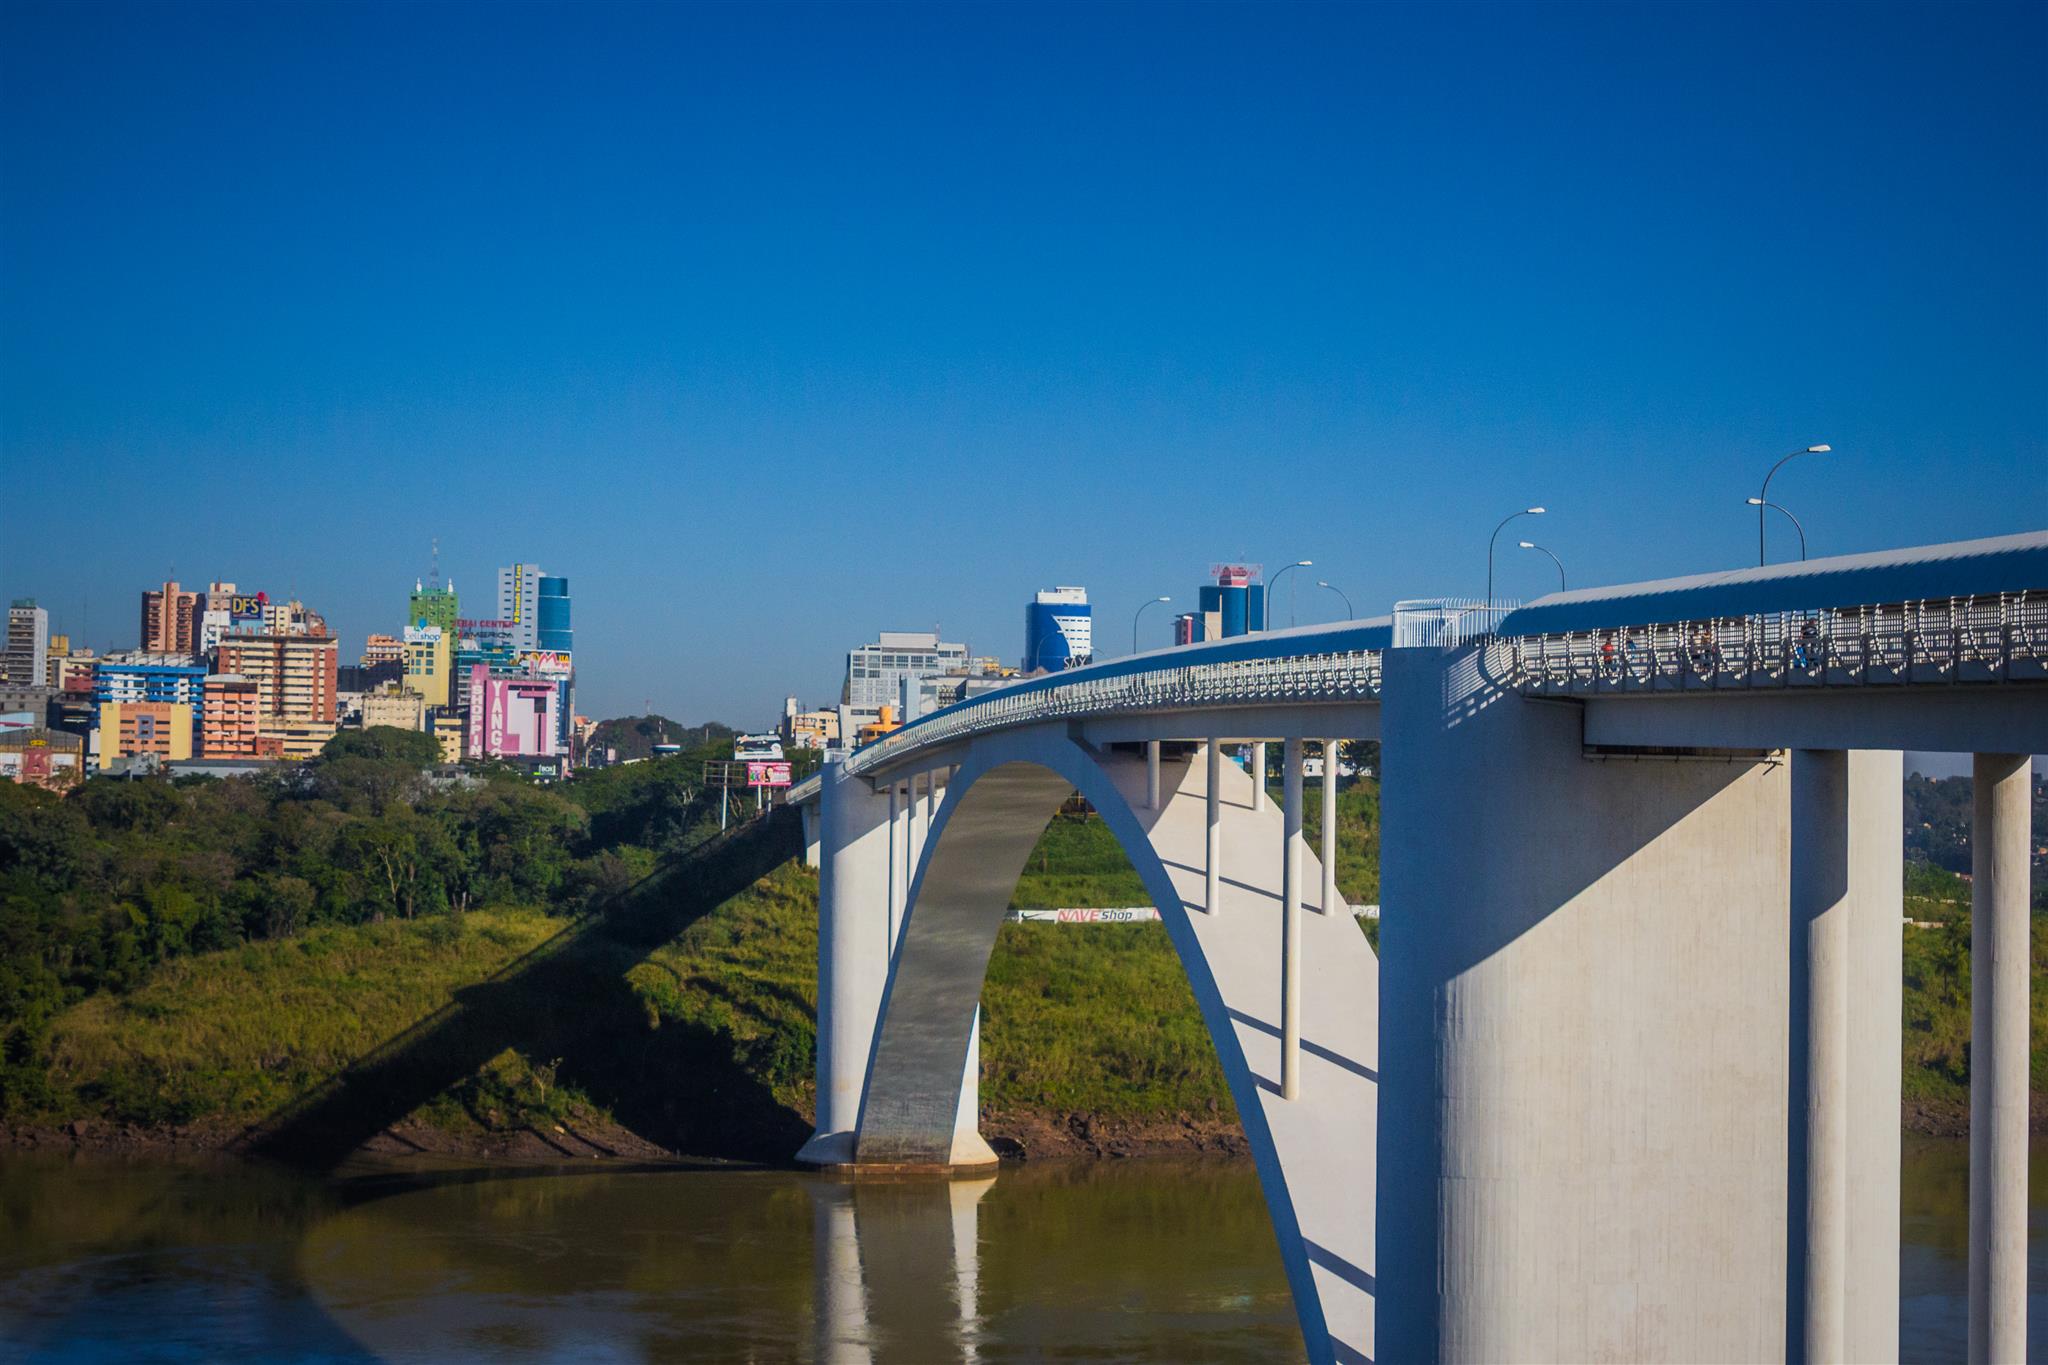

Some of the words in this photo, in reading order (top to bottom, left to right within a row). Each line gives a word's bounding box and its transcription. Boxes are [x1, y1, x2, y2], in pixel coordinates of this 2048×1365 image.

[232, 598, 259, 614] DFS
[1063, 656, 1088, 670] SAX
[470, 684, 483, 757] SHOPPIN
[1057, 909, 1099, 922] NAVE
